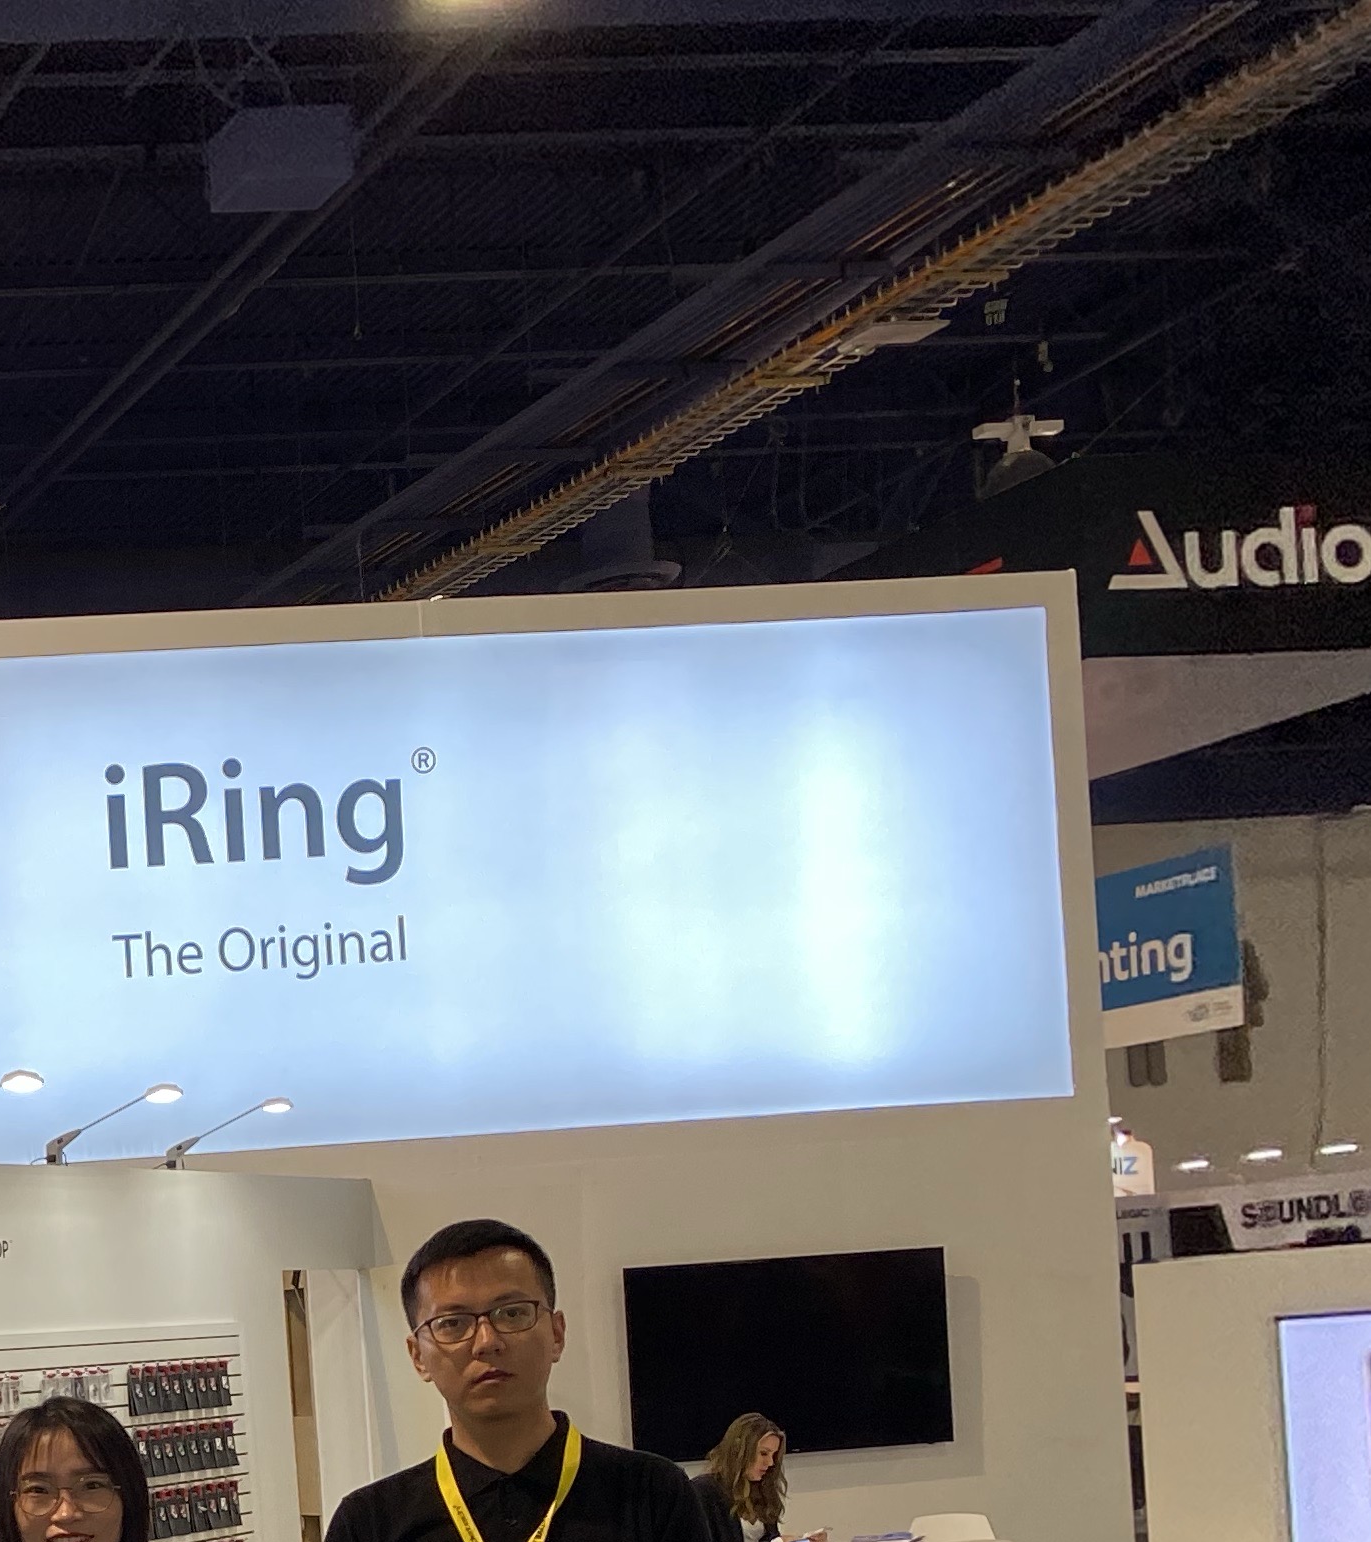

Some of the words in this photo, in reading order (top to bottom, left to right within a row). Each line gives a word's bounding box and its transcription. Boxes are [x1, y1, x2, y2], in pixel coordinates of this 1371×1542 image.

[1134, 865, 1219, 899] MARKETPLACE
[111, 930, 204, 979] The
[217, 914, 408, 980] Original
